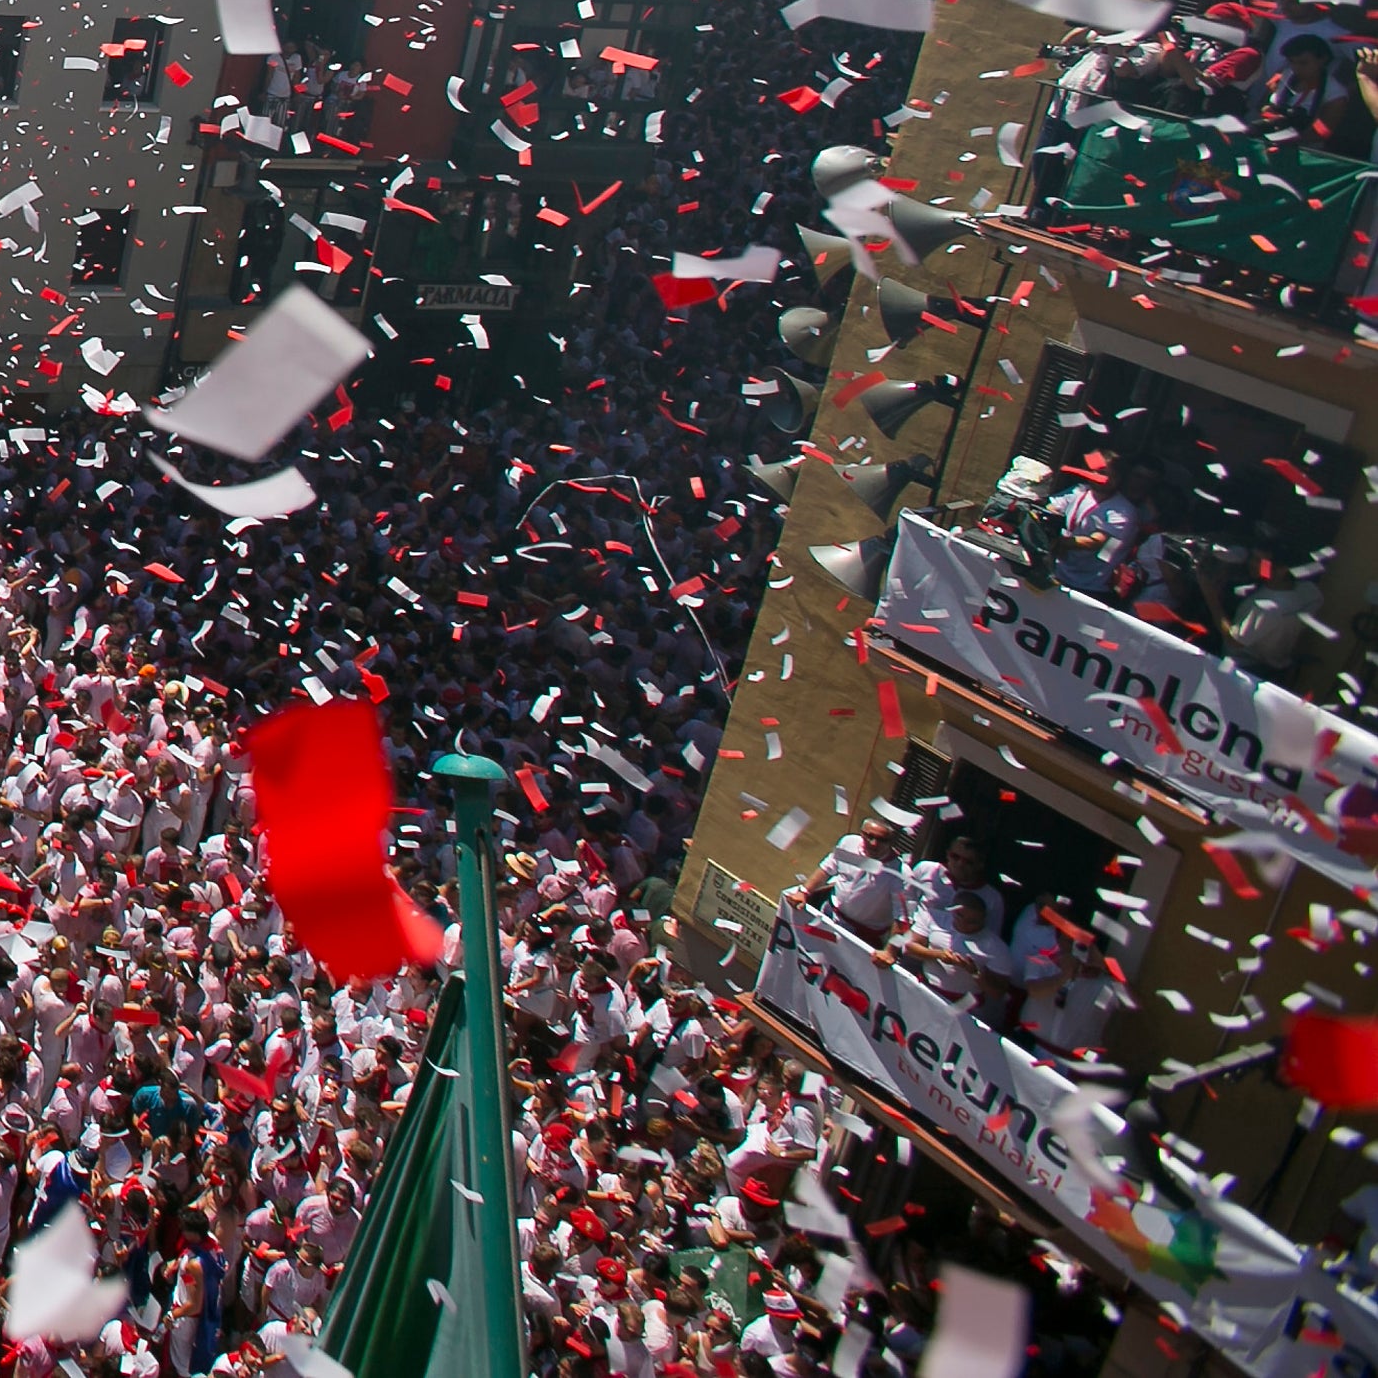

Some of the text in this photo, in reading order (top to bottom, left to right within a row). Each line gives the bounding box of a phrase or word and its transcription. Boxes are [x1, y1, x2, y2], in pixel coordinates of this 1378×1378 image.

[898, 1055, 1063, 1195] tu me plais!
